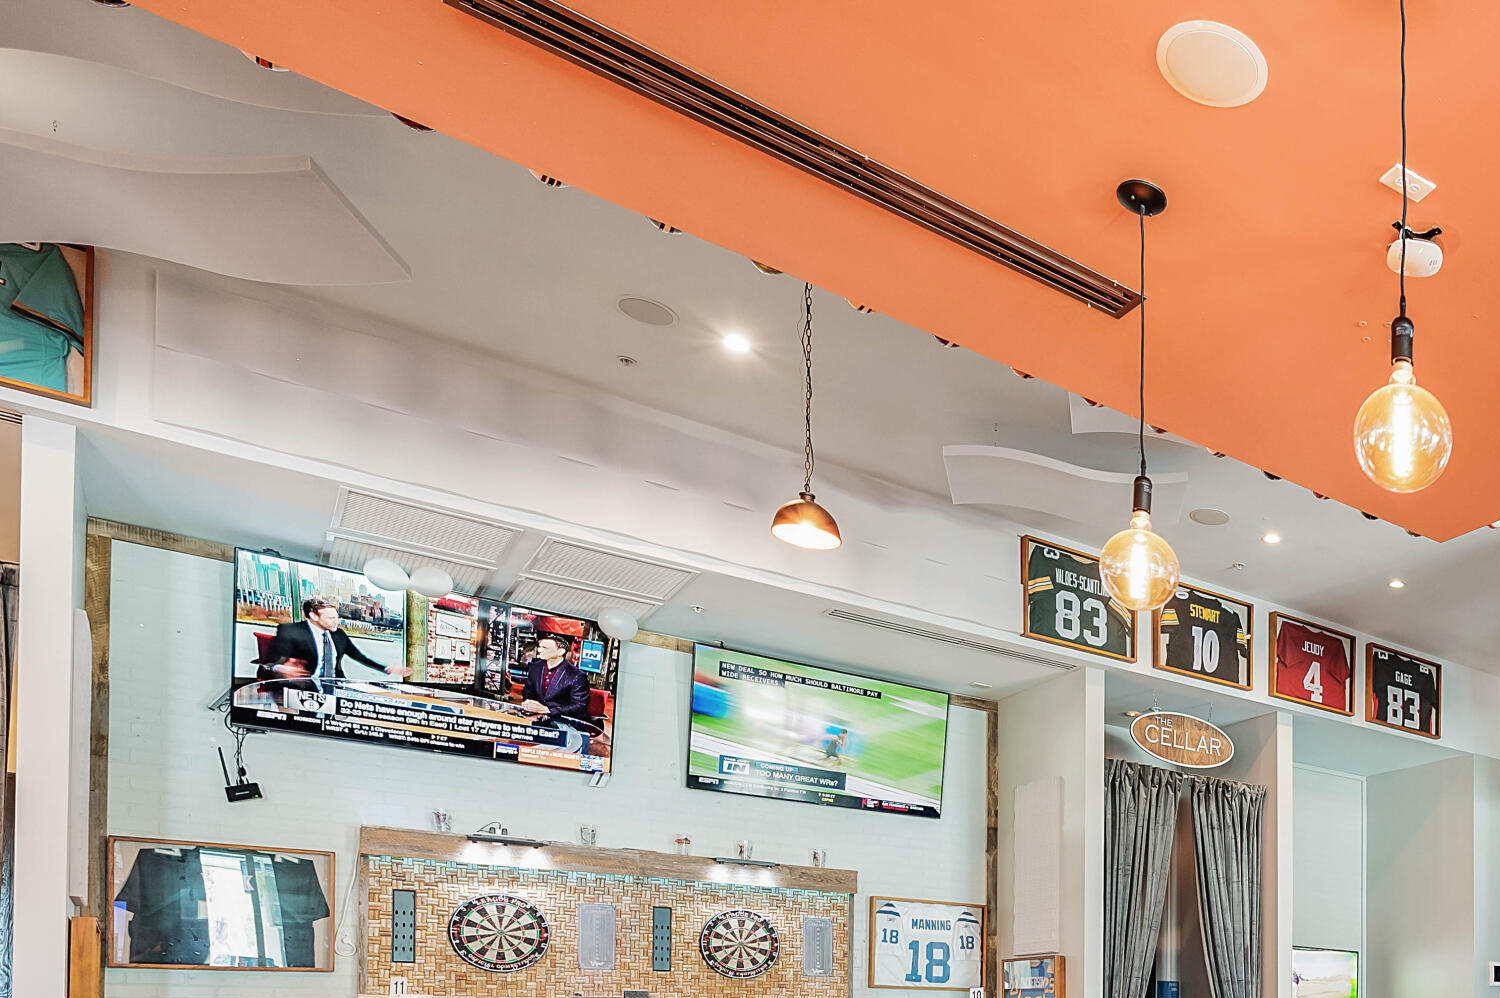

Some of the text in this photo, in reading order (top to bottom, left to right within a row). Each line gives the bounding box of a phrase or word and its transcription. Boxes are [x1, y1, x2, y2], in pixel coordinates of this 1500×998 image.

[1055, 590, 1108, 647] 83
[1190, 603, 1220, 624] STEWART
[1191, 625, 1220, 673] 10
[1302, 640, 1325, 657] JEUDY
[721, 670, 779, 686] WIDE RECEIVERS
[721, 662, 736, 671] NEW
[738, 665, 755, 674] DEAL
[770, 671, 783, 679] HOW
[785, 675, 802, 683] MUCH
[804, 679, 829, 688] SHOULD
[831, 683, 865, 696] BALTIMORE
[866, 690, 879, 698] PAY
[1303, 661, 1324, 703] 4
[1395, 671, 1413, 686] GAGE
[297, 691, 327, 703] NETS
[1386, 685, 1420, 730] 83
[340, 699, 560, 739] Do Nets have enough around star players to win the East?
[1155, 716, 1173, 727] THE
[1144, 724, 1222, 757] CELLAR
[756, 769, 772, 778] TOO
[773, 771, 794, 780] MANY
[795, 774, 818, 783] GREAT
[911, 918, 951, 931] MANNING
[881, 928, 899, 944] 18
[960, 935, 975, 950] 18
[905, 940, 950, 983] 18
[394, 981, 404, 994] 11
